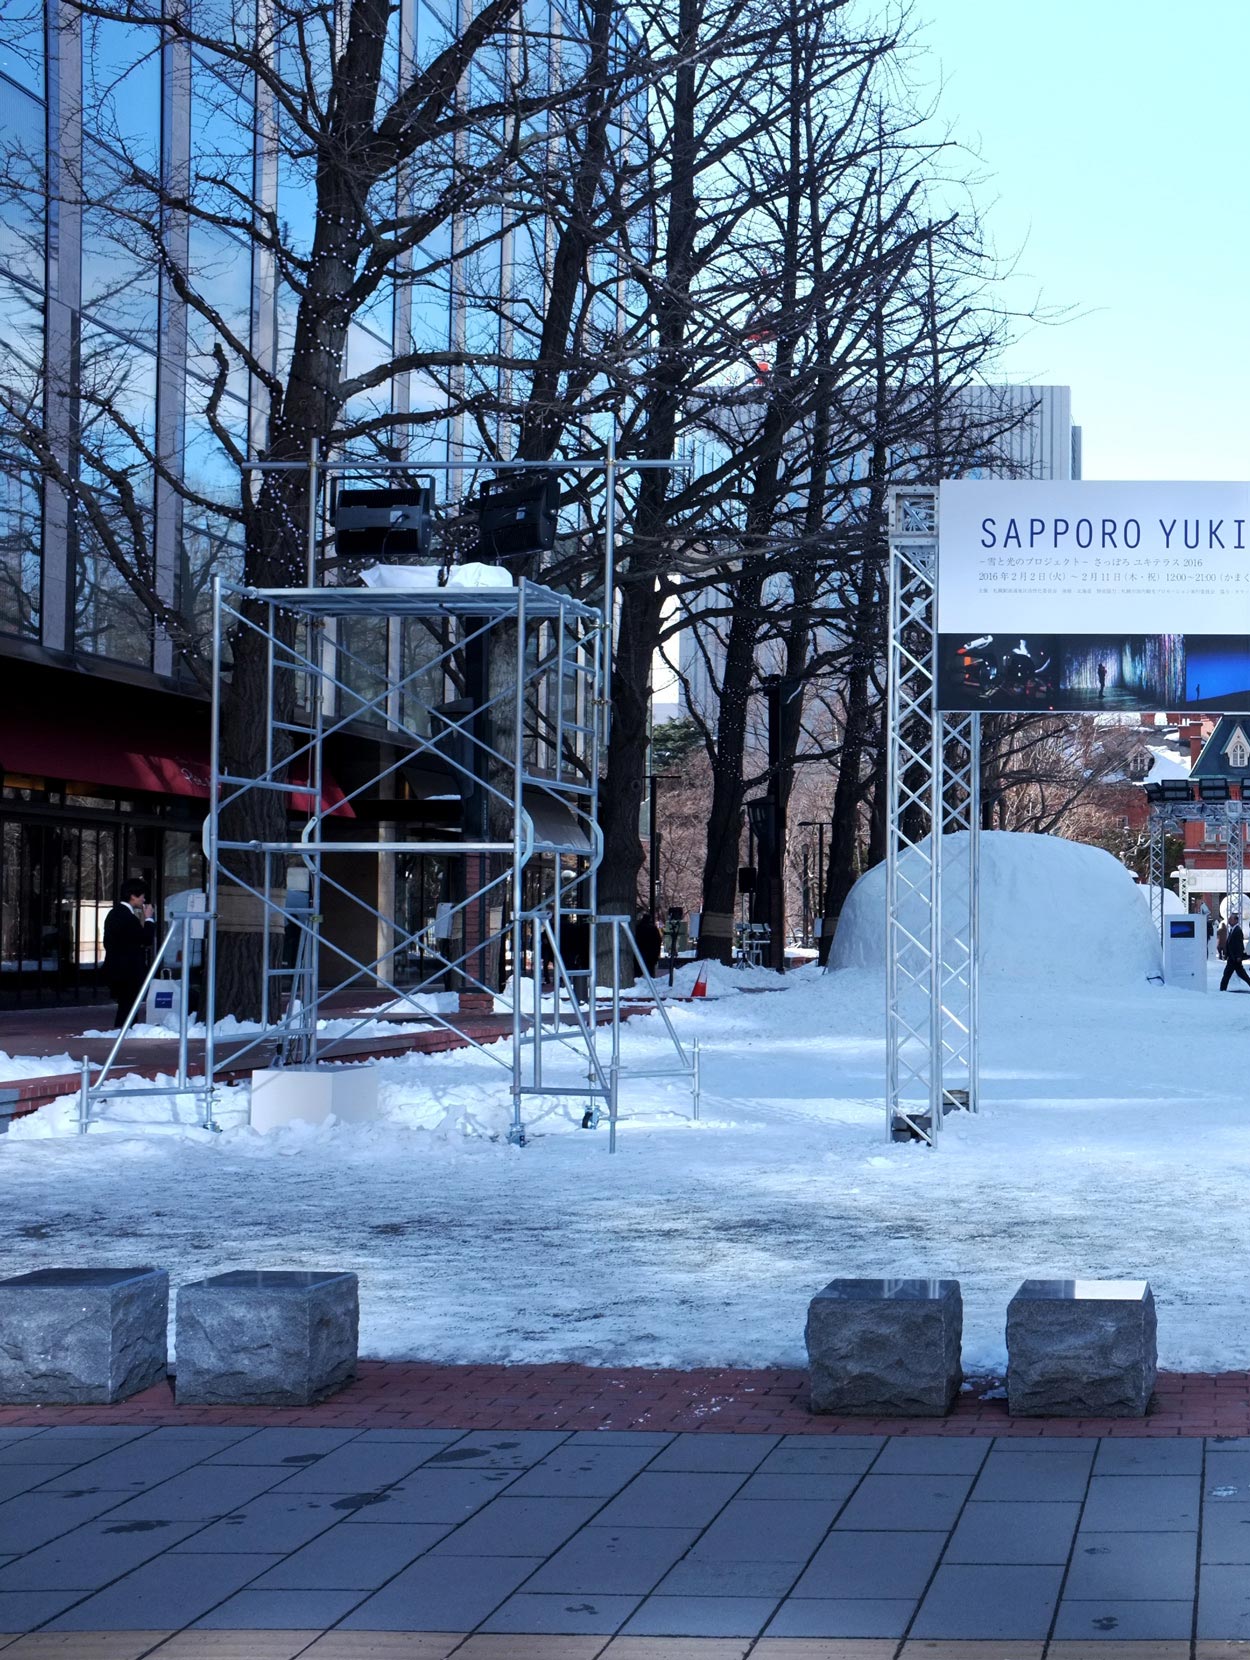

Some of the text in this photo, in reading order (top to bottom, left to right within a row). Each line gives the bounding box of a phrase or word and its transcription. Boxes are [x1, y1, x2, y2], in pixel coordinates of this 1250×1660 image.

[980, 517, 1141, 549] SAPPORO
[1094, 557, 1130, 568] さっぽろ
[1133, 557, 1180, 568] ユキテラス
[1183, 558, 1203, 568] 2016
